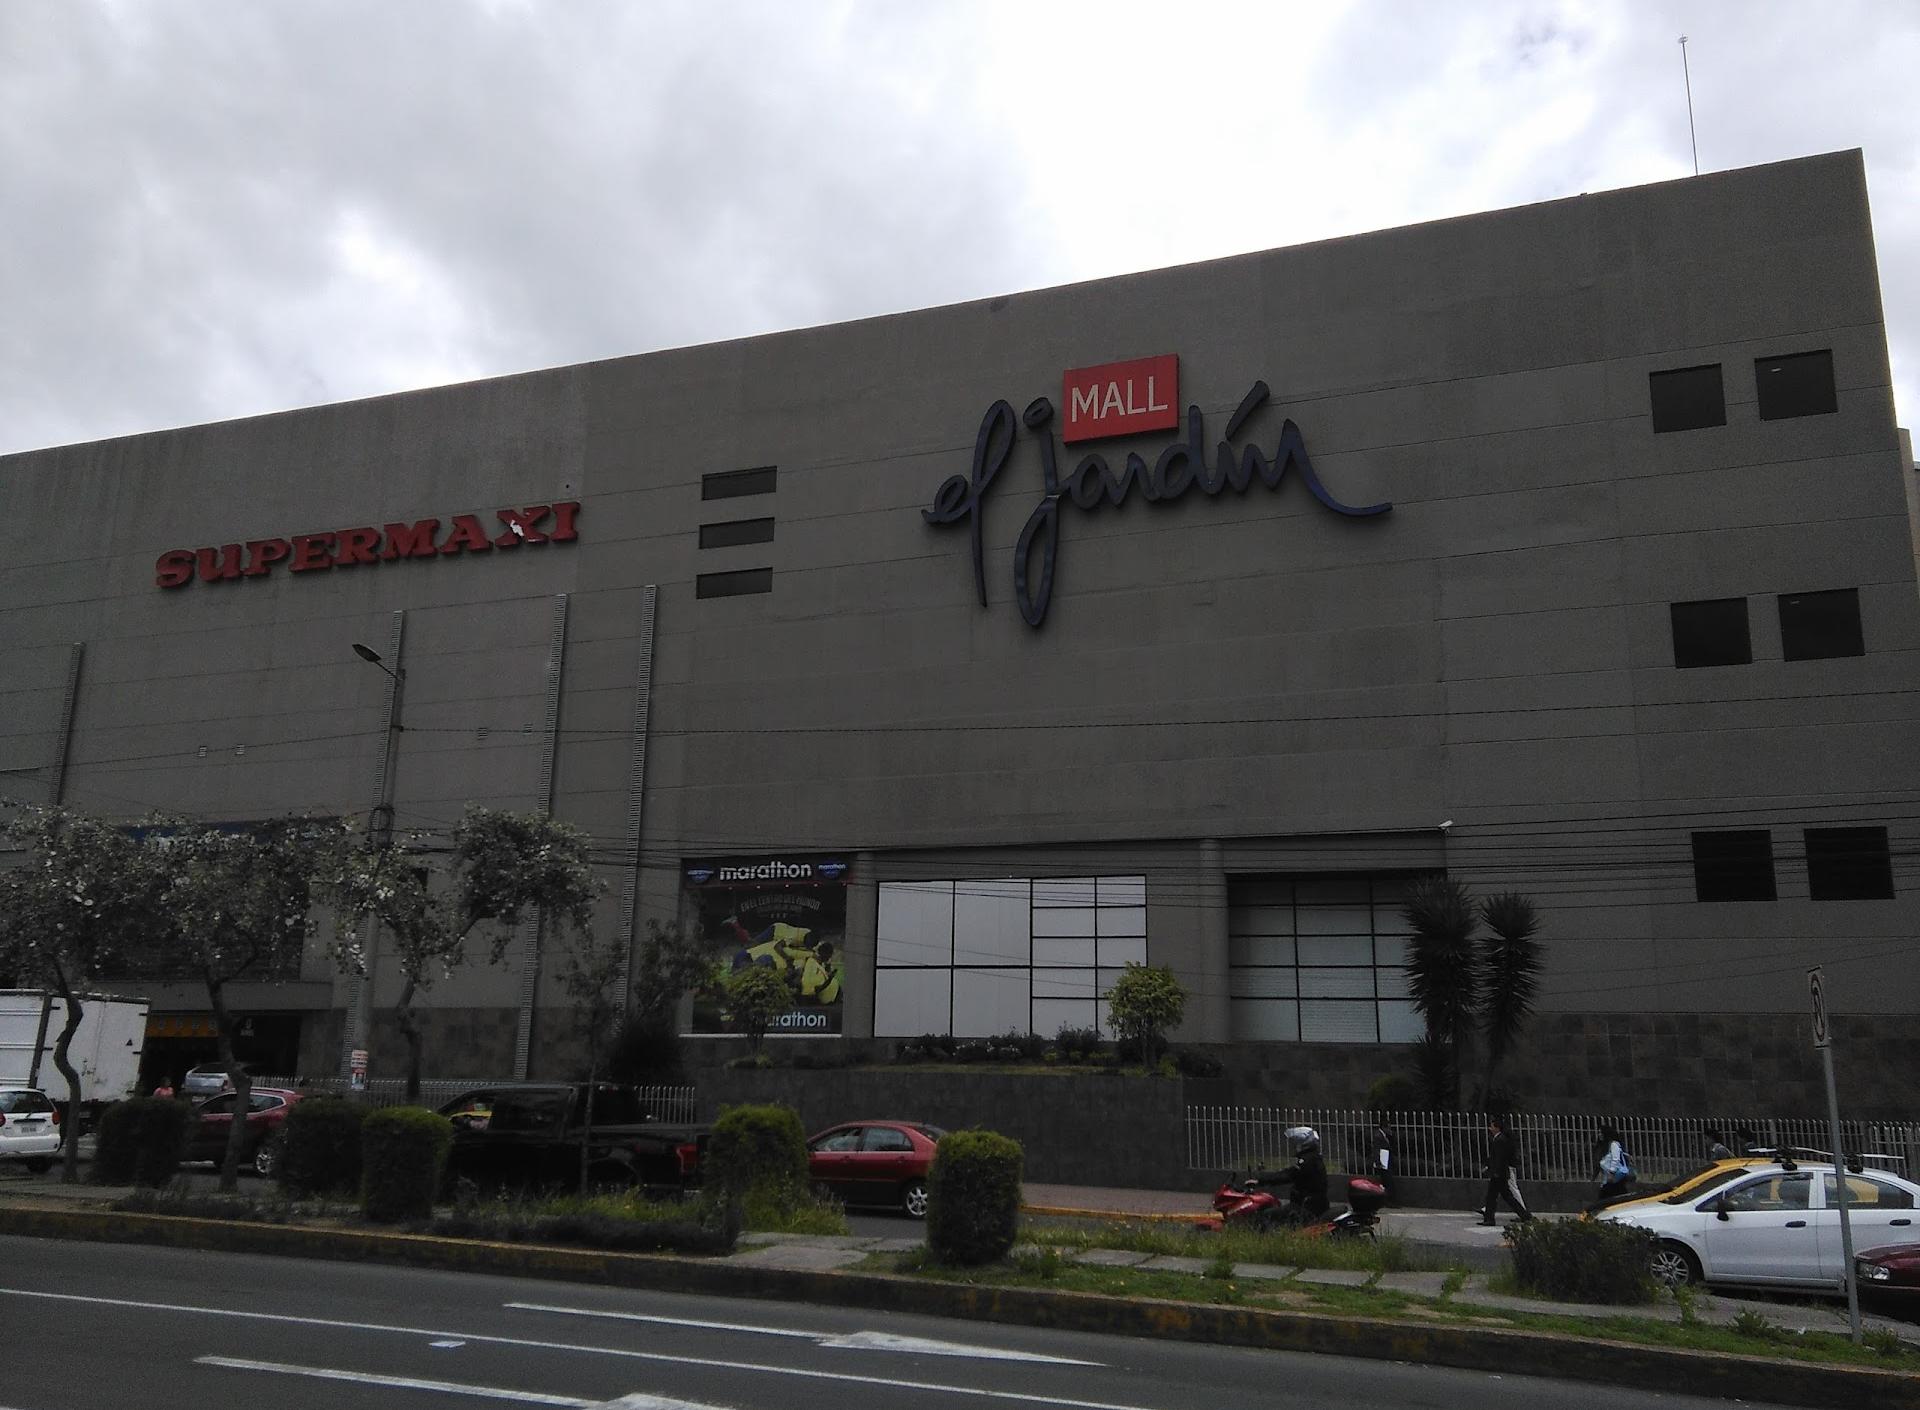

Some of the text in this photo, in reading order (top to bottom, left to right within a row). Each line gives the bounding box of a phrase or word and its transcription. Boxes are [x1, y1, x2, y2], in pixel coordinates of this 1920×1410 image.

[1071, 375, 1168, 422] MALL
[920, 380, 1392, 626] el jardín
[156, 502, 579, 589] SUPERMAXI
[720, 861, 812, 881] marathon
